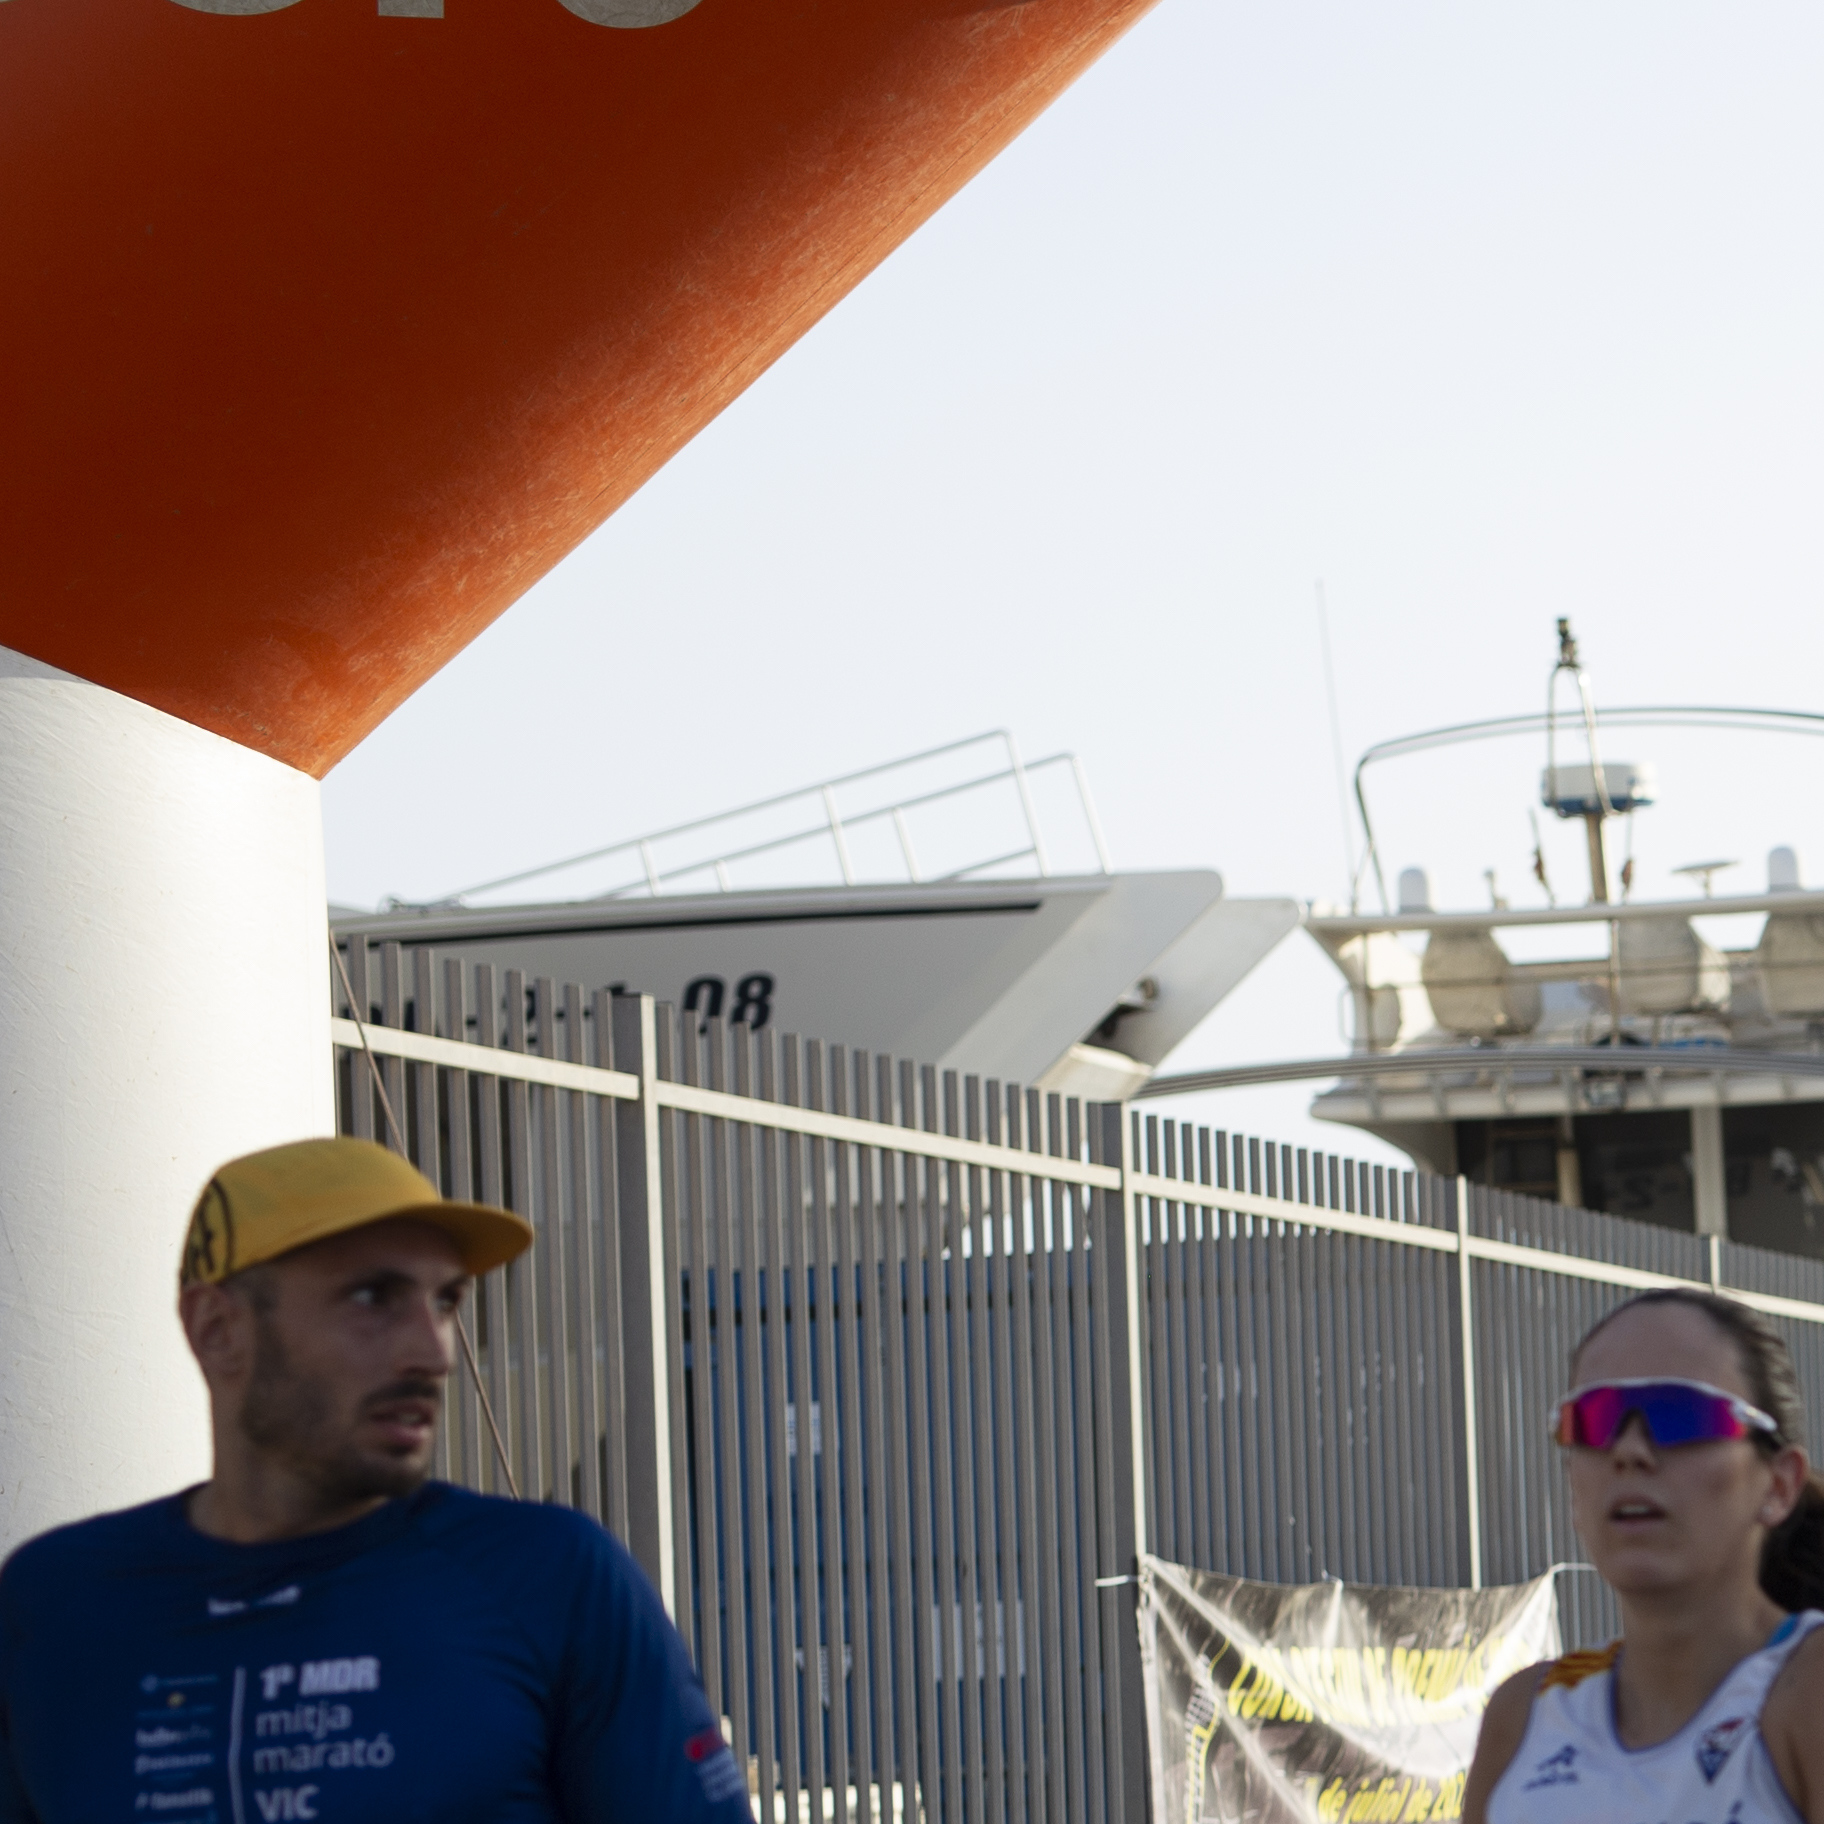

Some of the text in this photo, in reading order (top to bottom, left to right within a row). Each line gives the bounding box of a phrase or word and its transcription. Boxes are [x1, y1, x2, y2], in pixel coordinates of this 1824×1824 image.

[300, 1655, 380, 1696] MDR
[256, 1701, 352, 1738] mitja
[253, 1733, 395, 1774] marató
[254, 1784, 319, 1821] VIC
